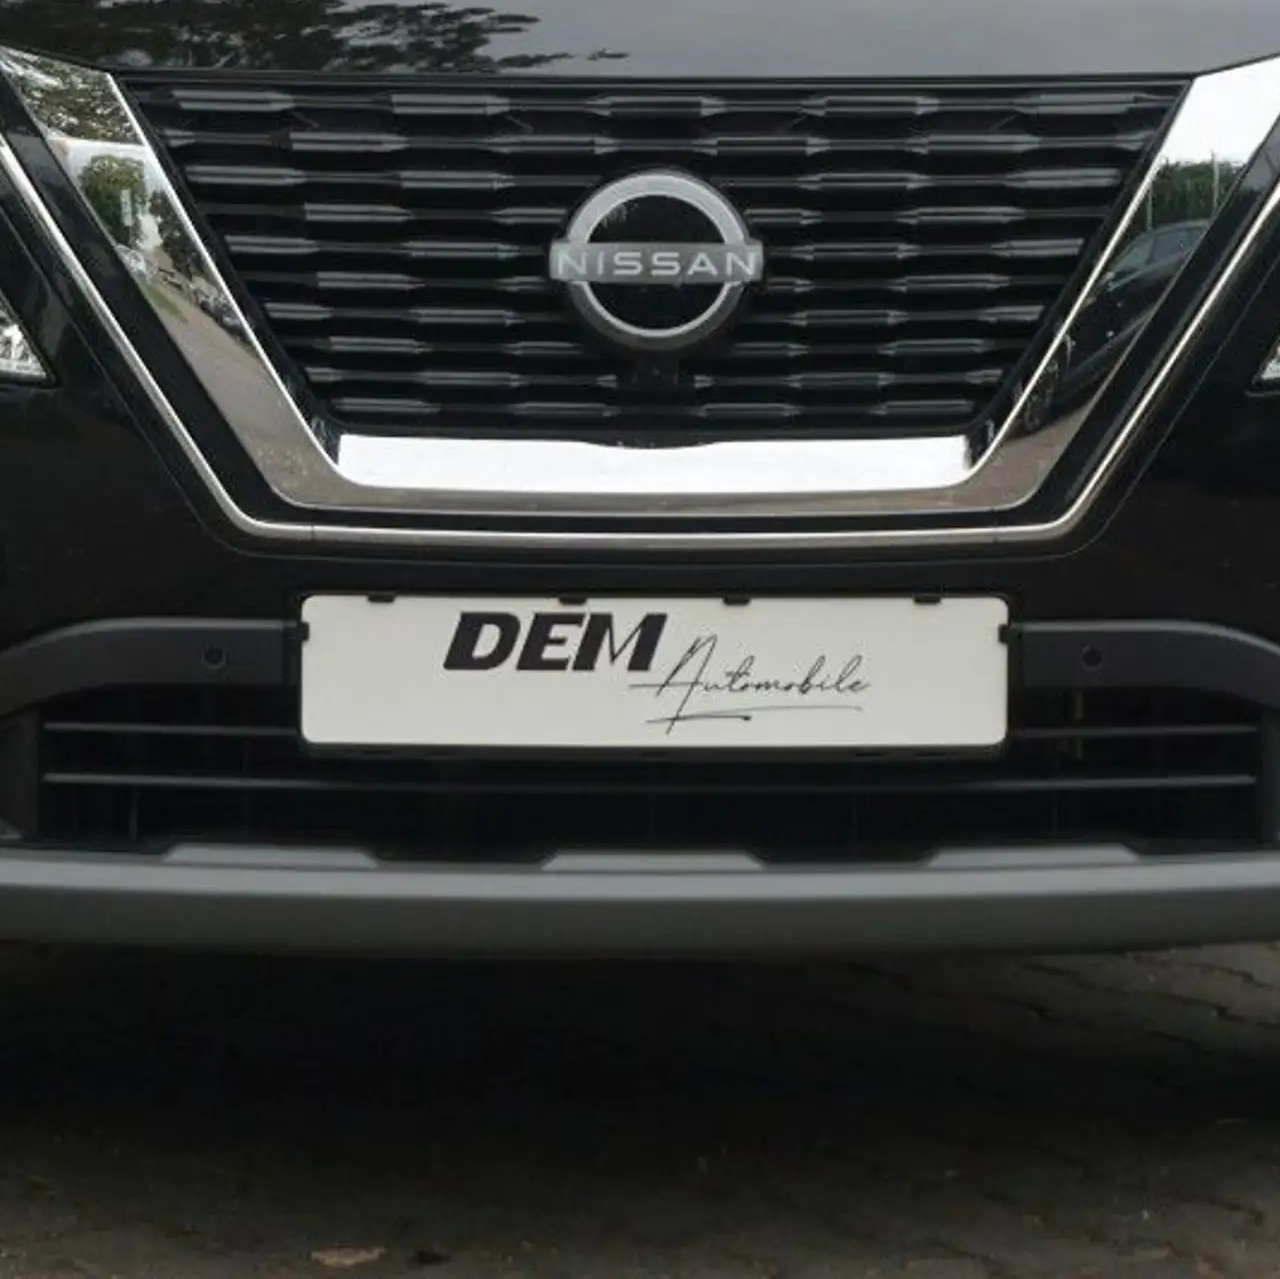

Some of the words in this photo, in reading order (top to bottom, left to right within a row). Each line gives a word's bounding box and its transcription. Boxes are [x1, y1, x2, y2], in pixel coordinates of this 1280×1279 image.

[557, 250, 757, 277] NISSAN
[443, 612, 668, 671] DEM
[629, 633, 872, 735] Automobile
